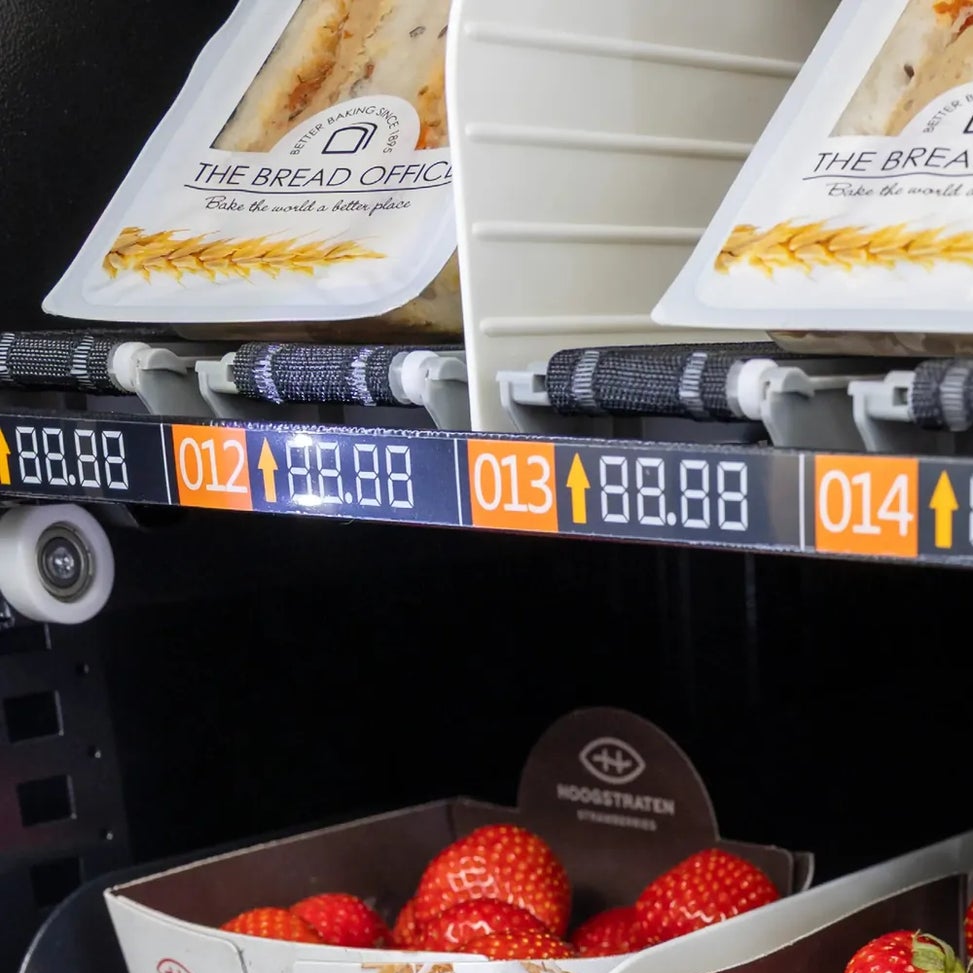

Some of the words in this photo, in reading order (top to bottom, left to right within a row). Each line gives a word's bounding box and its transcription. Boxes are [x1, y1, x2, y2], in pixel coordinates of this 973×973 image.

[327, 105, 376, 125] BAKING
[376, 107, 400, 130] SINCE
[923, 99, 963, 133] BETTER
[290, 123, 324, 155] BETTER
[382, 130, 401, 154] 1895
[814, 151, 877, 172] THE
[194, 162, 249, 185] THE
[251, 167, 352, 187] BREAD
[879, 181, 904, 197] the
[205, 195, 246, 211] Bake
[248, 197, 267, 213] the
[271, 198, 315, 213] world
[316, 203, 328, 213] a
[331, 199, 371, 213] better
[368, 197, 412, 216] place
[15, 426, 129, 490] 88.88
[178, 437, 249, 494] 012
[473, 452, 553, 514] 013
[600, 455, 748, 531] 88.88
[818, 469, 914, 537] 014
